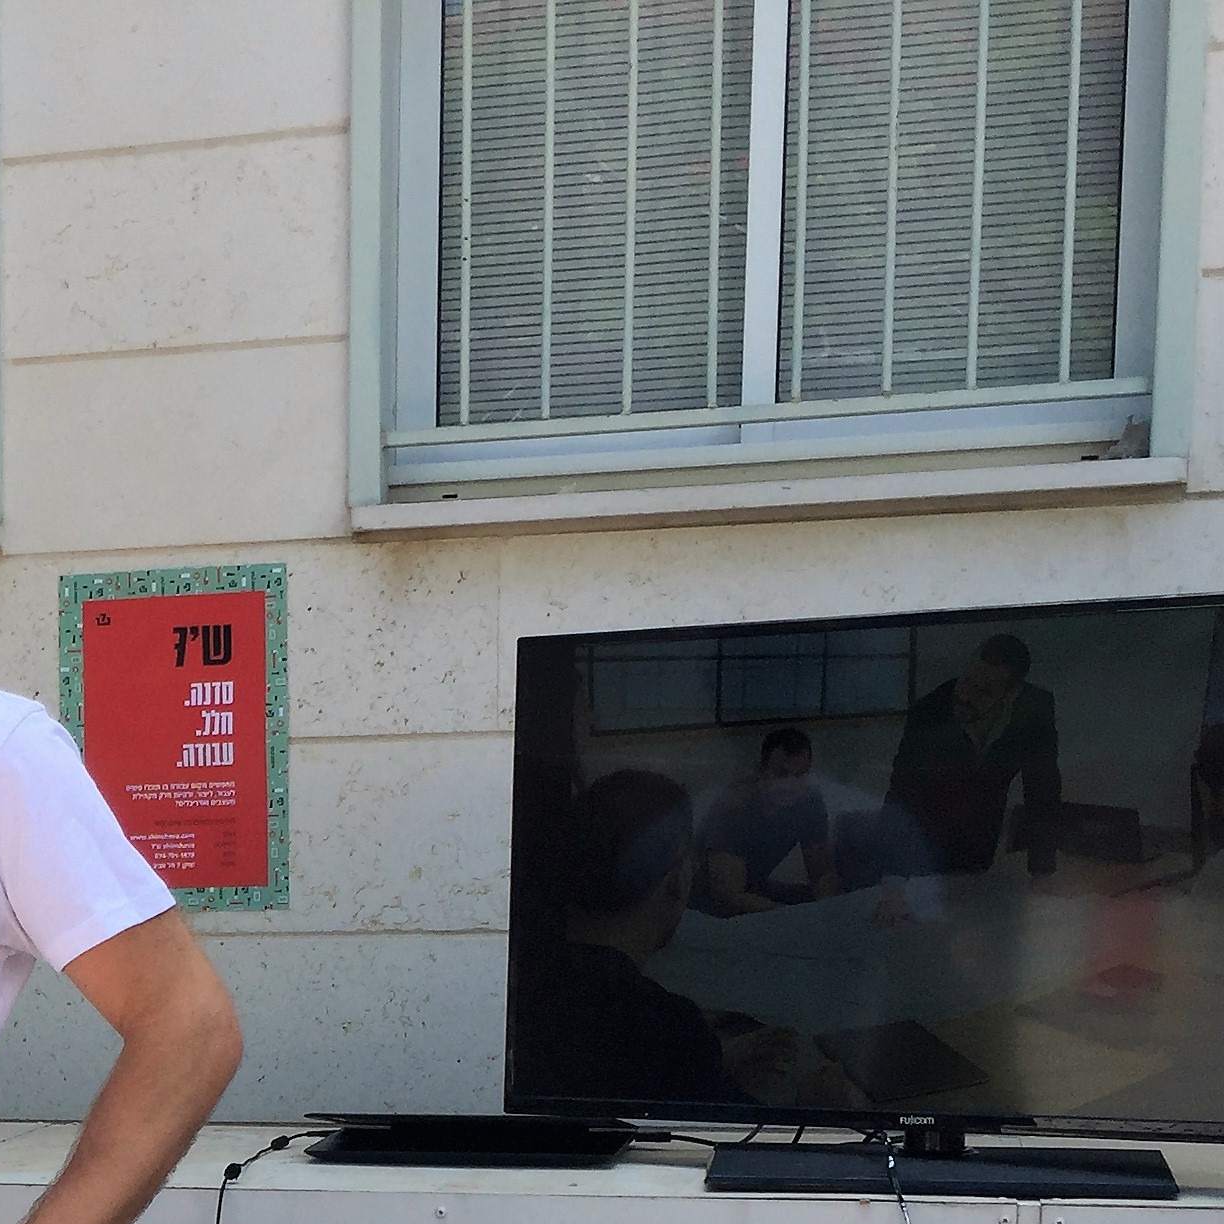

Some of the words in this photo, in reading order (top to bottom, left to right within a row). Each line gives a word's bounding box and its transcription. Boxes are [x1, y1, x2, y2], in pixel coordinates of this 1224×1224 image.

[184, 681, 234, 707] סדנה.
[195, 709, 233, 737] חלל.
[176, 742, 234, 768] עבודה.
